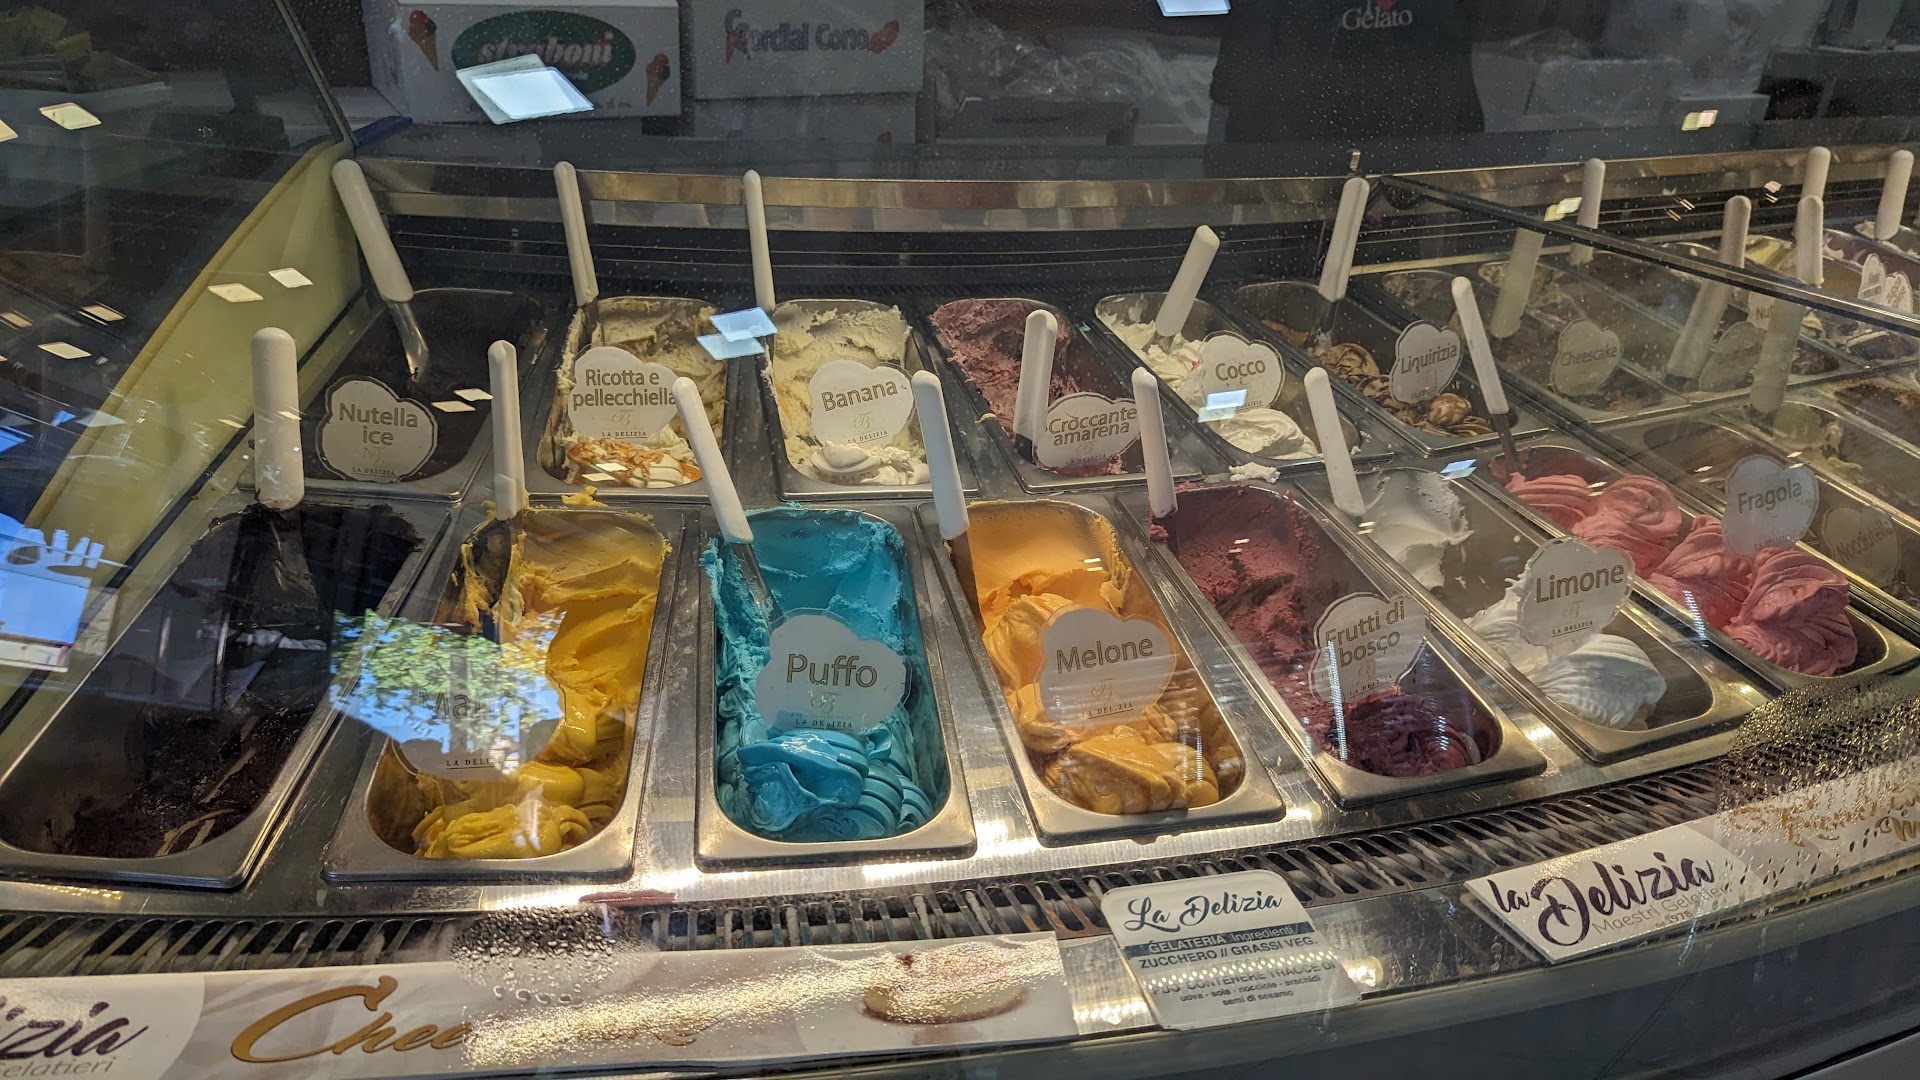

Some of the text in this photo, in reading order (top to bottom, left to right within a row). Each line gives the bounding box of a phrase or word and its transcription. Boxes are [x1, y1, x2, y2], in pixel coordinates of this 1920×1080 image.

[1342, 6, 1414, 31] Gelato
[1215, 360, 1266, 381] Cocco
[1401, 343, 1457, 374] Liquirizia
[585, 368, 660, 386] Ricotta e
[573, 387, 676, 411] pellecchiella
[821, 381, 898, 411] Banana
[339, 402, 418, 428] Nutella
[1048, 407, 1138, 434] Croccante
[362, 425, 394, 446] ice
[1053, 421, 1130, 446] amarena
[1738, 478, 1802, 514] Fragola
[1536, 564, 1624, 603] Limone
[1325, 600, 1405, 645] Frutti di
[1056, 638, 1154, 674] Melone
[1339, 631, 1401, 667] bosco
[786, 653, 878, 688] Puffo
[1124, 891, 1282, 933] La Delizia
[1530, 852, 1715, 946] Delizia
[1591, 904, 1660, 934] Maestri
[1139, 950, 1217, 969] ZUCCHERO
[1231, 940, 1283, 956] GRASSI
[1284, 936, 1318, 947] VEG.
[1148, 924, 1294, 954] GELATERIA Ingredienti
[1180, 993, 1204, 1002] uova
[1211, 988, 1231, 998] soia
[1284, 974, 1321, 987] arachidi
[1222, 990, 1294, 1006] semi di sesamo
